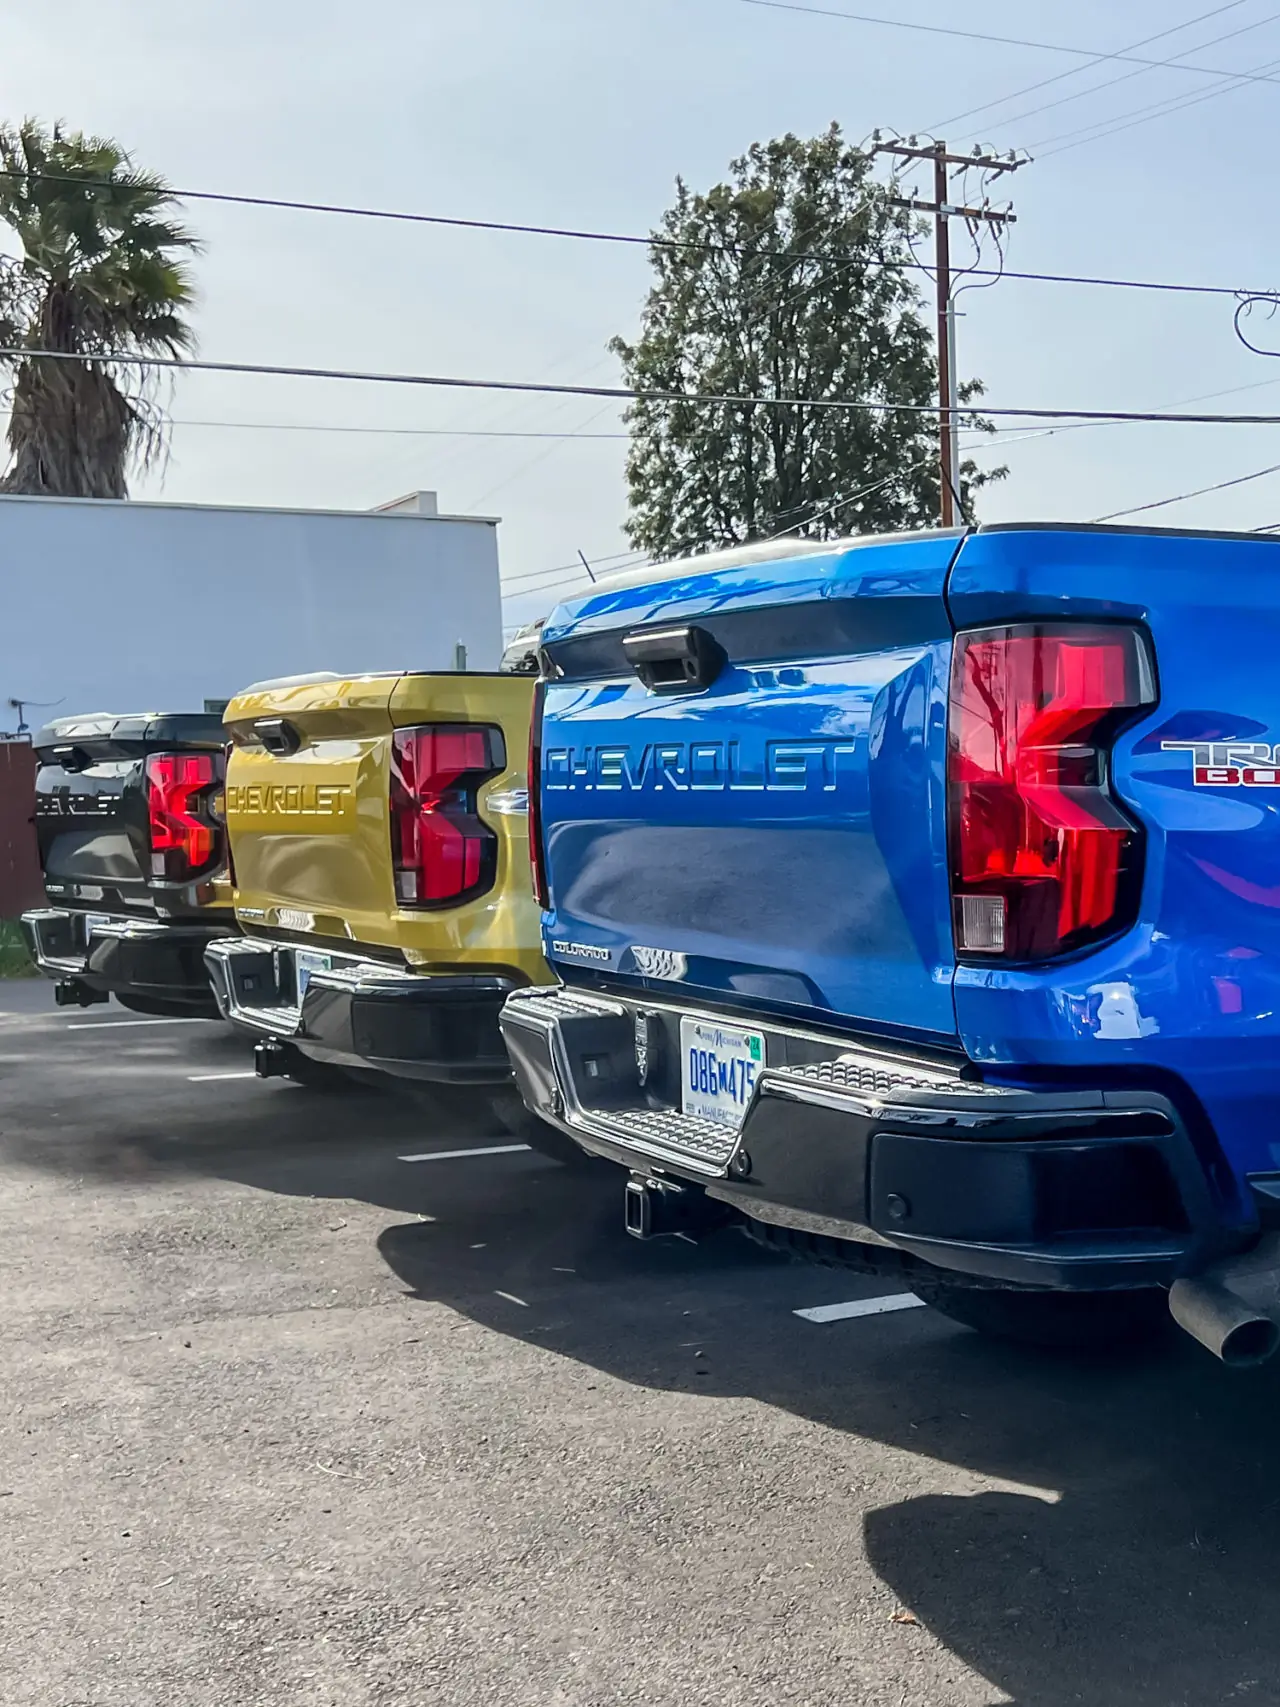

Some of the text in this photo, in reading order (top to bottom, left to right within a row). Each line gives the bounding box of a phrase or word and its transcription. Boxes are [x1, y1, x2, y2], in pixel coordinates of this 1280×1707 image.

[545, 737, 856, 791] CHEVROLET
[226, 784, 351, 815] CHEVROLET
[552, 940, 610, 961] COLORADO
